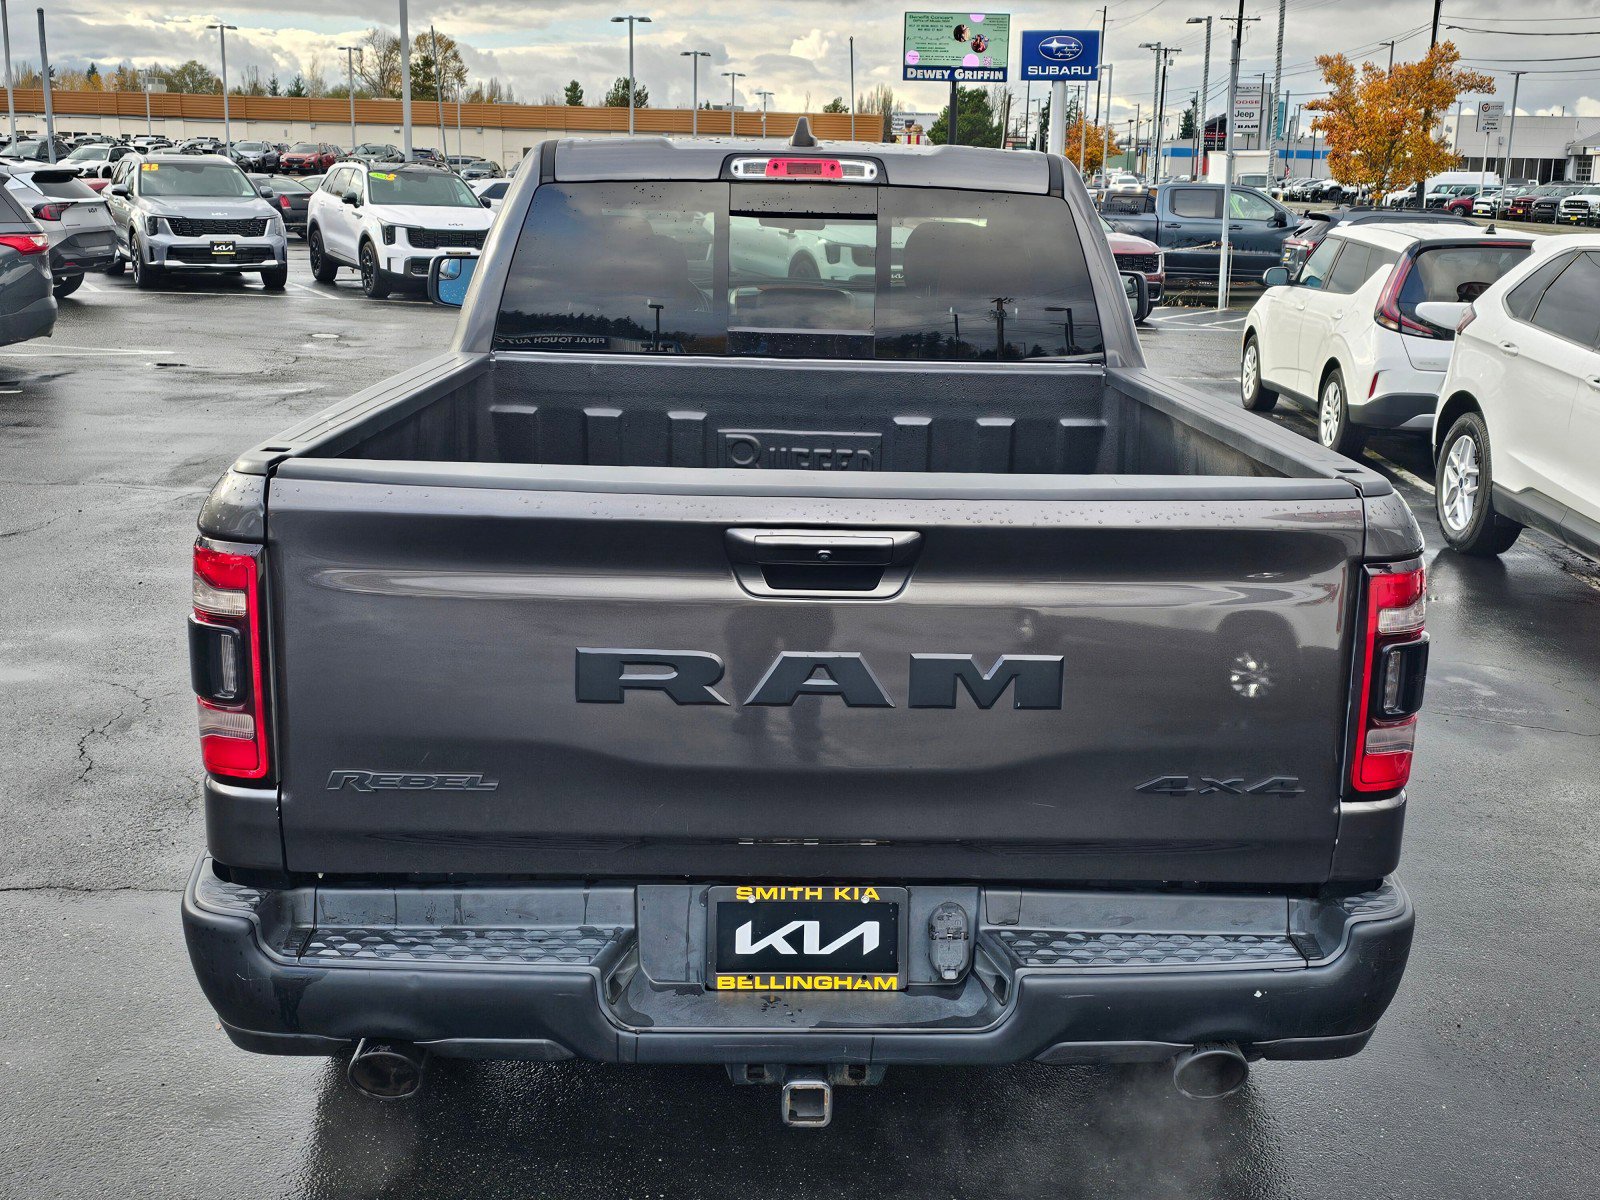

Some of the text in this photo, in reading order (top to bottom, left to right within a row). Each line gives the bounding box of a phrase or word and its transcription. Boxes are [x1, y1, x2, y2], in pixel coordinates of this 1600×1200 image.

[906, 67, 1004, 80] DEWEY GRIFFIN
[1028, 66, 1092, 75] SUBARU
[1235, 110, 1255, 119] Jeep
[576, 647, 1065, 709] RAM
[325, 769, 500, 792] REBEL
[735, 886, 880, 900] SMITH KIA
[735, 920, 880, 945] KIA
[716, 976, 897, 990] BELLINGHAM
